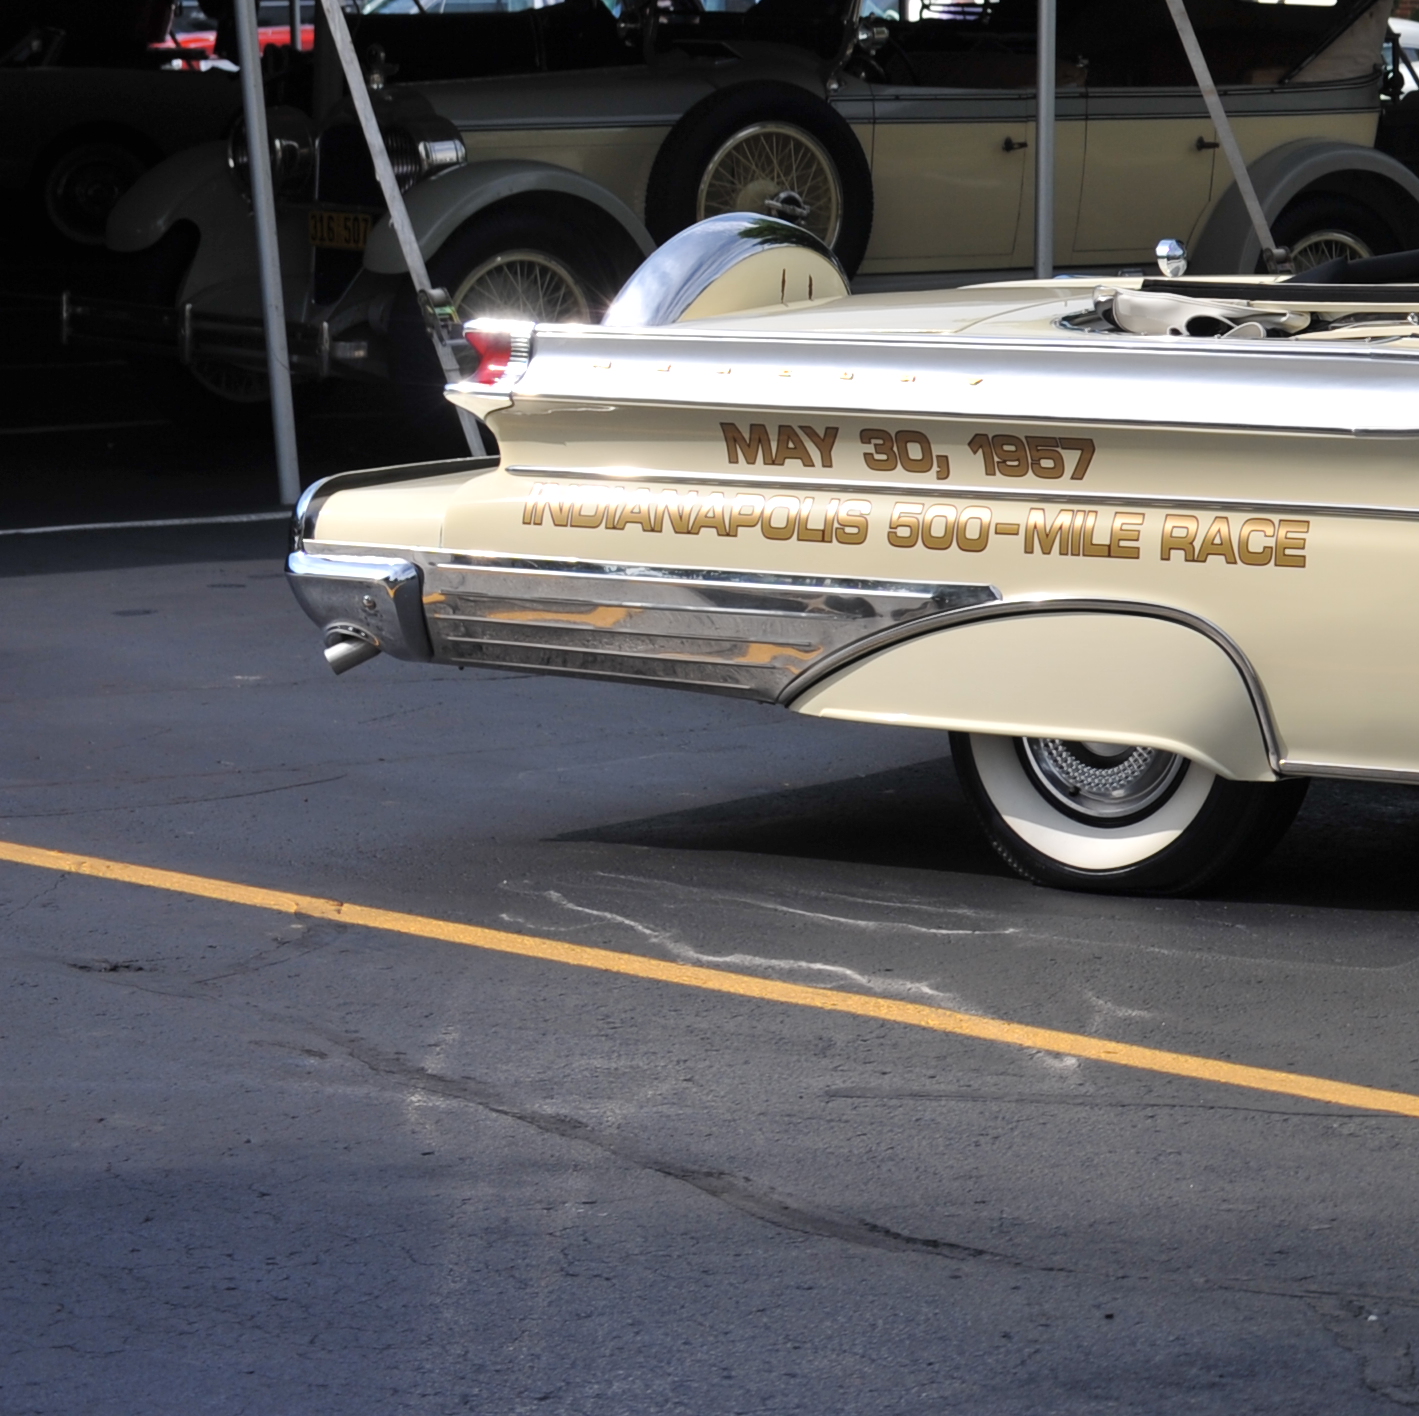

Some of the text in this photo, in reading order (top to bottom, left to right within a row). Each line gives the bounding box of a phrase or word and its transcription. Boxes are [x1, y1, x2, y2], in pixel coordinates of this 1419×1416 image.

[719, 421, 1097, 481] MAY 30, 1957
[521, 481, 1311, 569] INDIANAPOLIS 500-MILE RACE
